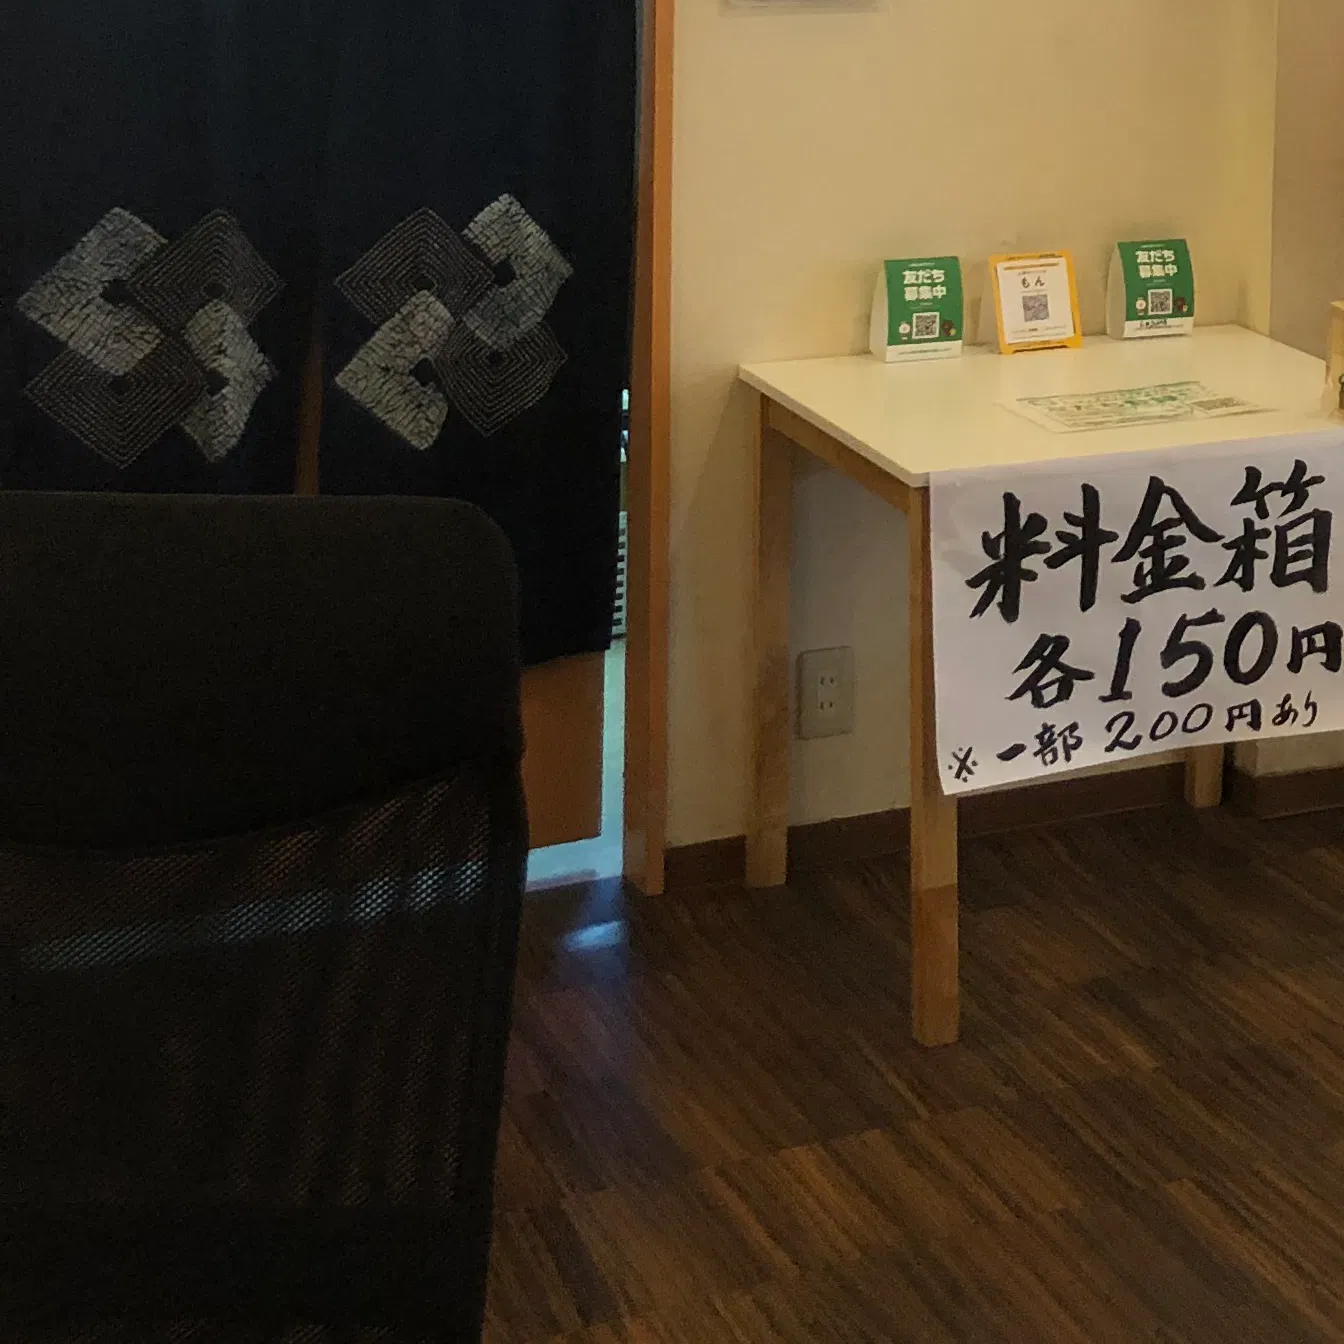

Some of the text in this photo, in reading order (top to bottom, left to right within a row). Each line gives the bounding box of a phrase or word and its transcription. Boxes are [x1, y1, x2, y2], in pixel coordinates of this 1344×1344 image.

[902, 269, 945, 284] 友だち
[1135, 249, 1175, 263] 友だち
[964, 458, 1334, 624] 料金箱
[1005, 607, 1344, 709] 各150円
